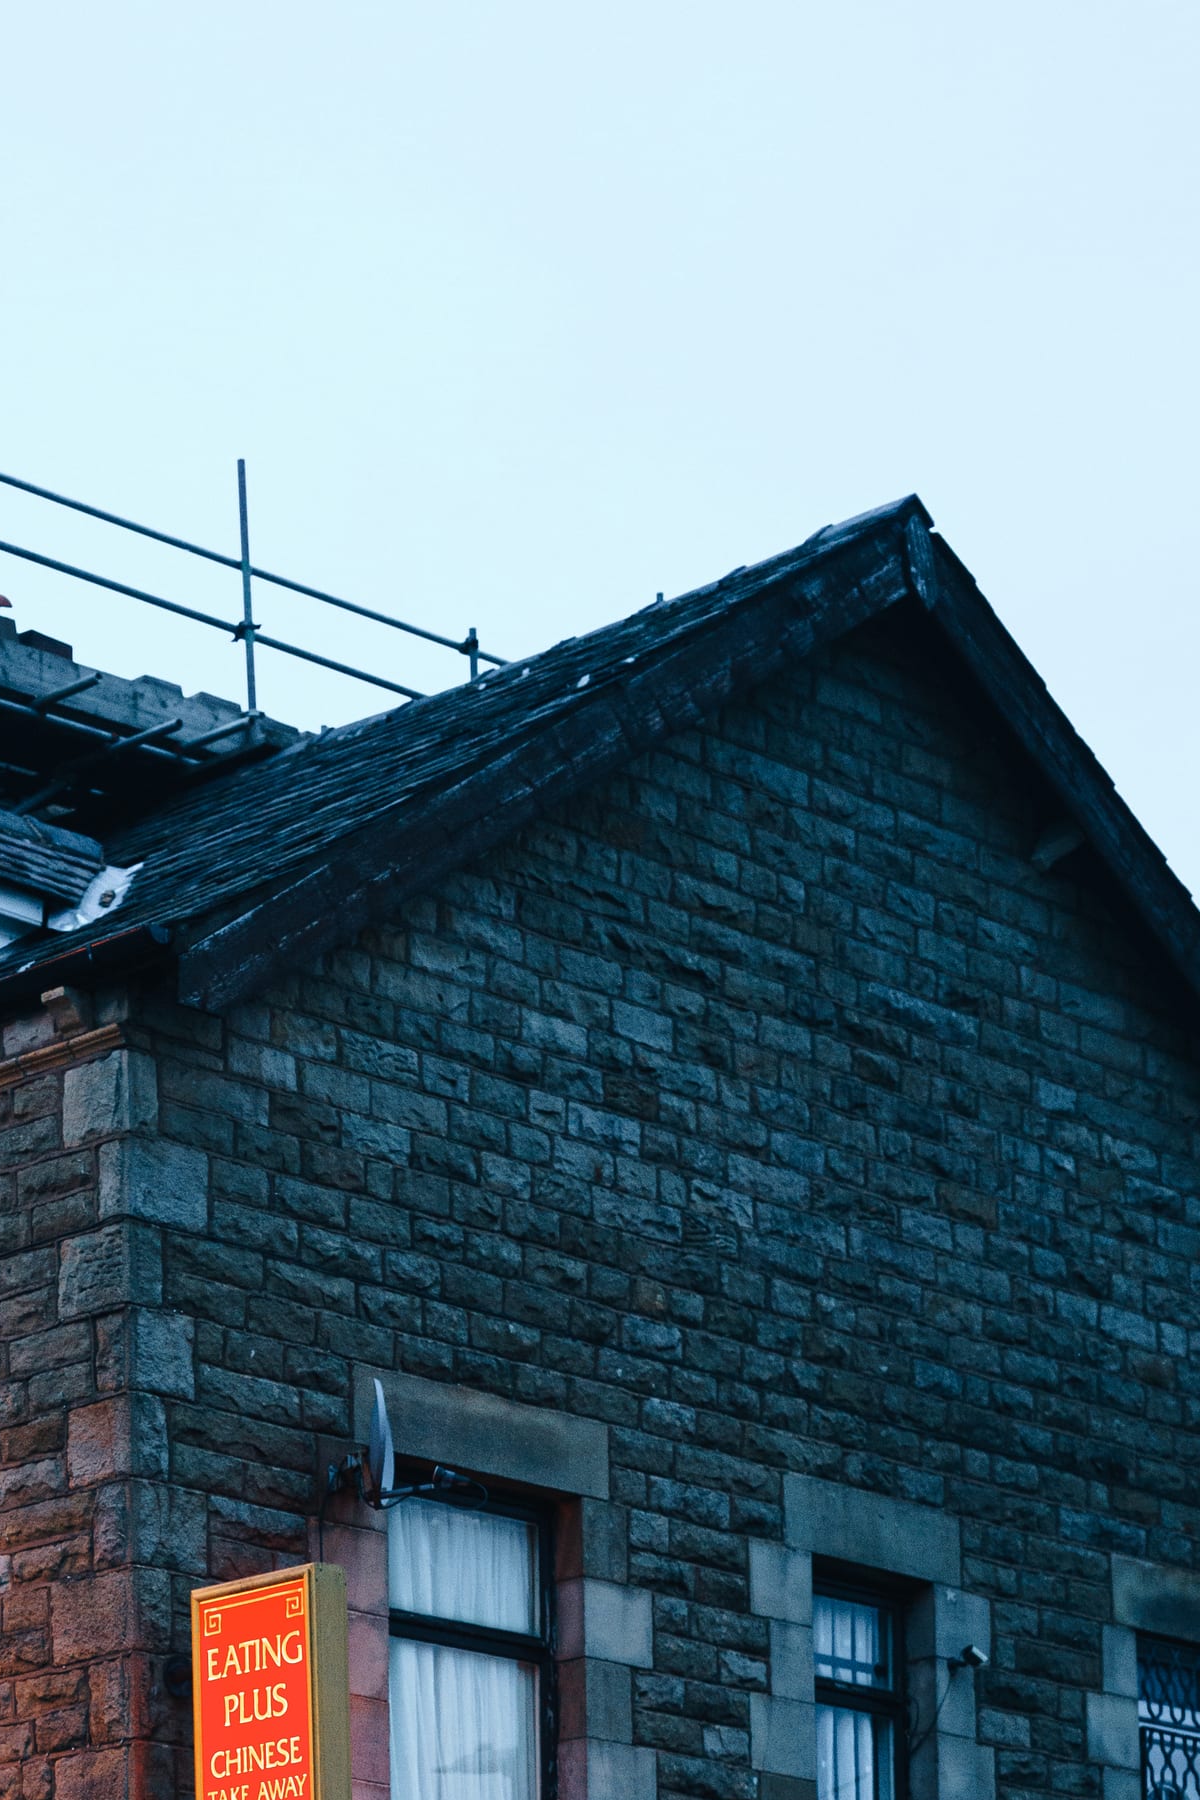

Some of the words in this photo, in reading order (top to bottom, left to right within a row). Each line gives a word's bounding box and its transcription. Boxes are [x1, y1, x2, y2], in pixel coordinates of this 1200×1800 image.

[207, 1630, 303, 1681] EATING
[224, 1683, 288, 1727] PLUS
[210, 1736, 303, 1779] CHINESE
